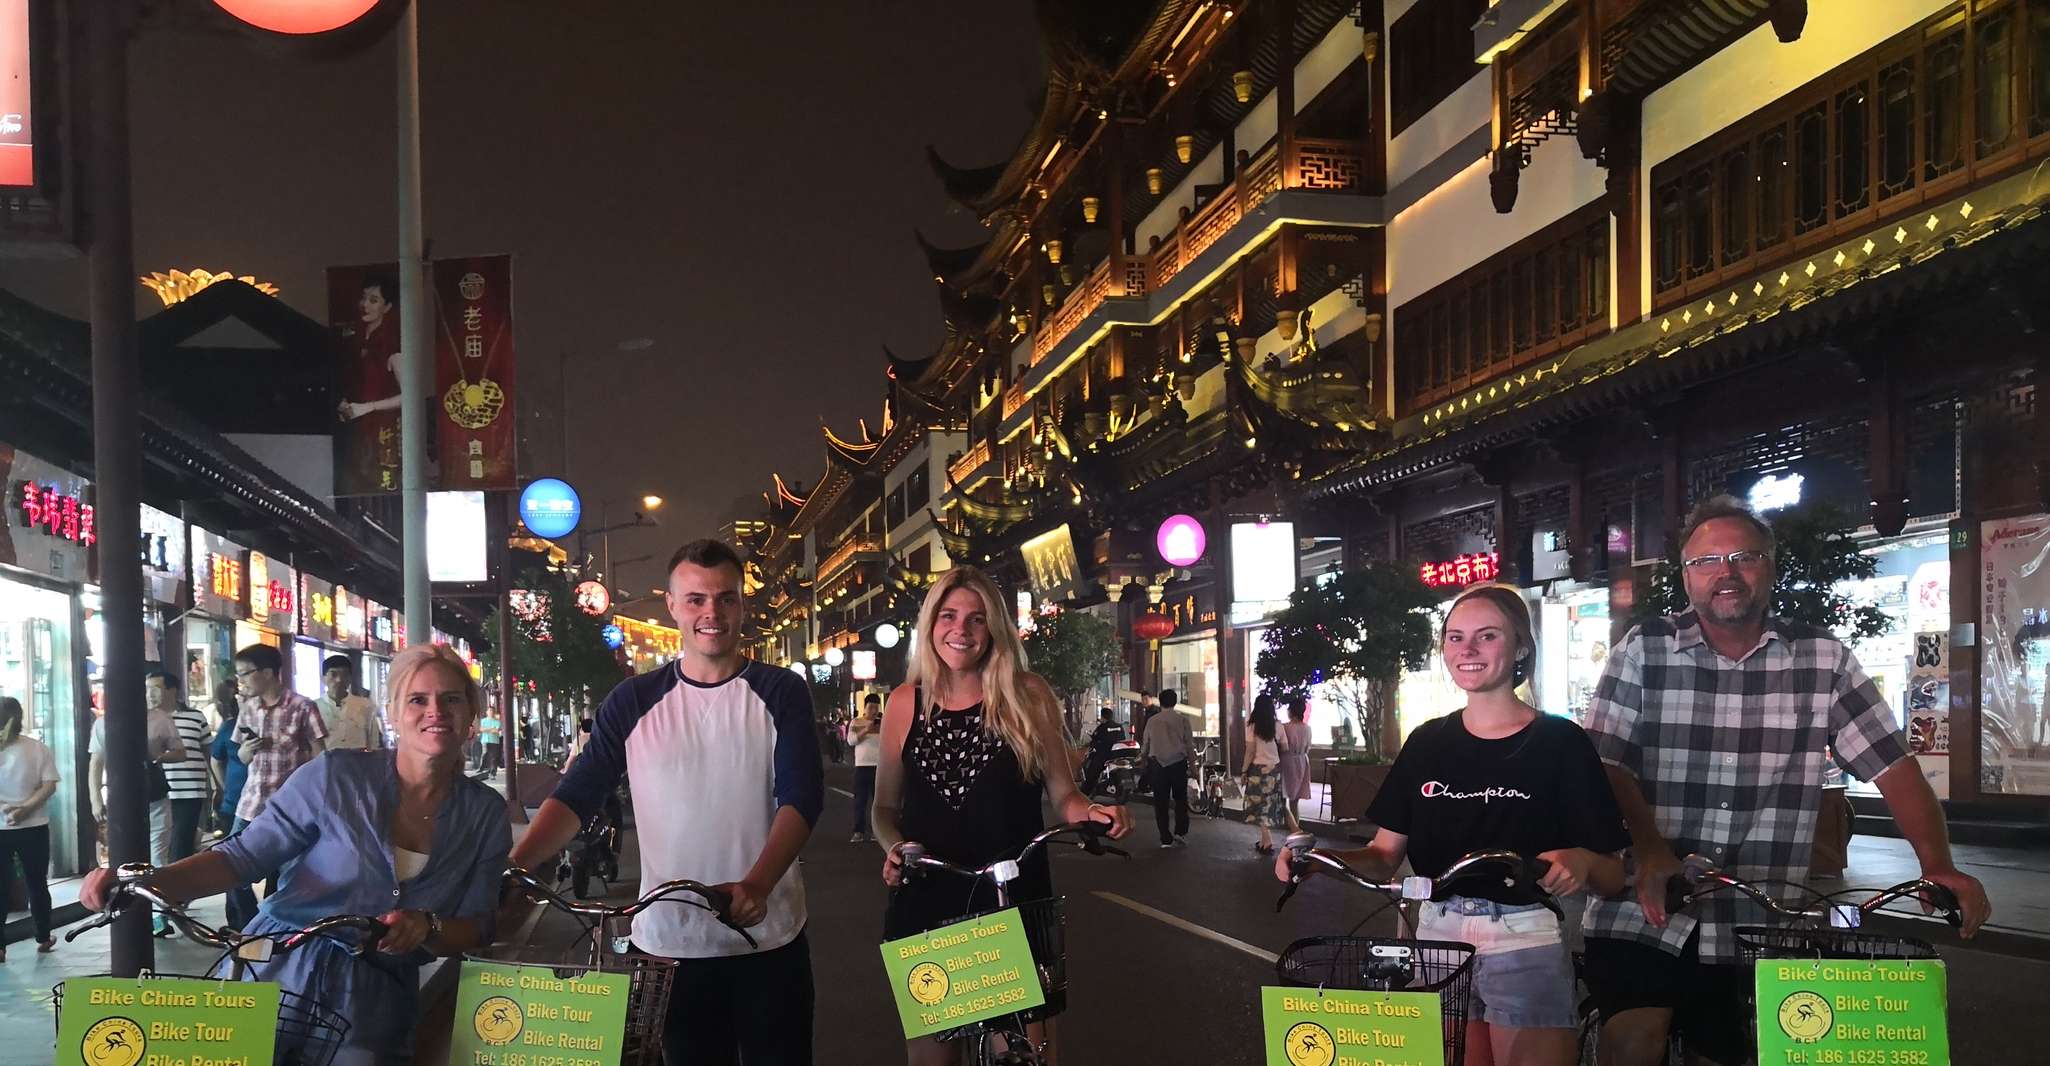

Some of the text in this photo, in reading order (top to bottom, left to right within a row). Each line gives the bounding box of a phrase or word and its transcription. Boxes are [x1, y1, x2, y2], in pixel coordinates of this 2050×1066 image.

[464, 305, 482, 358] 老庙
[1956, 531, 1967, 543] 29
[1421, 781, 1531, 804] Champion
[899, 921, 1008, 960] Bike China Tours
[946, 948, 1001, 973] Bike Tour
[480, 972, 612, 996] Bike China Tours
[952, 967, 1020, 997] Bike Rental
[1778, 967, 1926, 982] Bike China Tours
[89, 989, 257, 1009] Bike China Tours
[920, 987, 1027, 1027] Tel: 186 1625 3582
[1283, 997, 1421, 1018] Bike China Tours
[1835, 995, 1910, 1012] Bike Tour
[527, 1003, 559, 1020] Bike
[562, 1006, 594, 1023] Tour
[150, 1021, 235, 1042] Bike Tour
[523, 1030, 603, 1051] Bike Rental
[1336, 1027, 1406, 1048] Bike Tour
[1836, 1024, 1927, 1042] Bike Rental
[474, 1050, 497, 1066] Tel:
[501, 1052, 526, 1066] 186
[531, 1055, 564, 1066] 1625
[1785, 1049, 1928, 1065] Tel: 186 1625 3582
